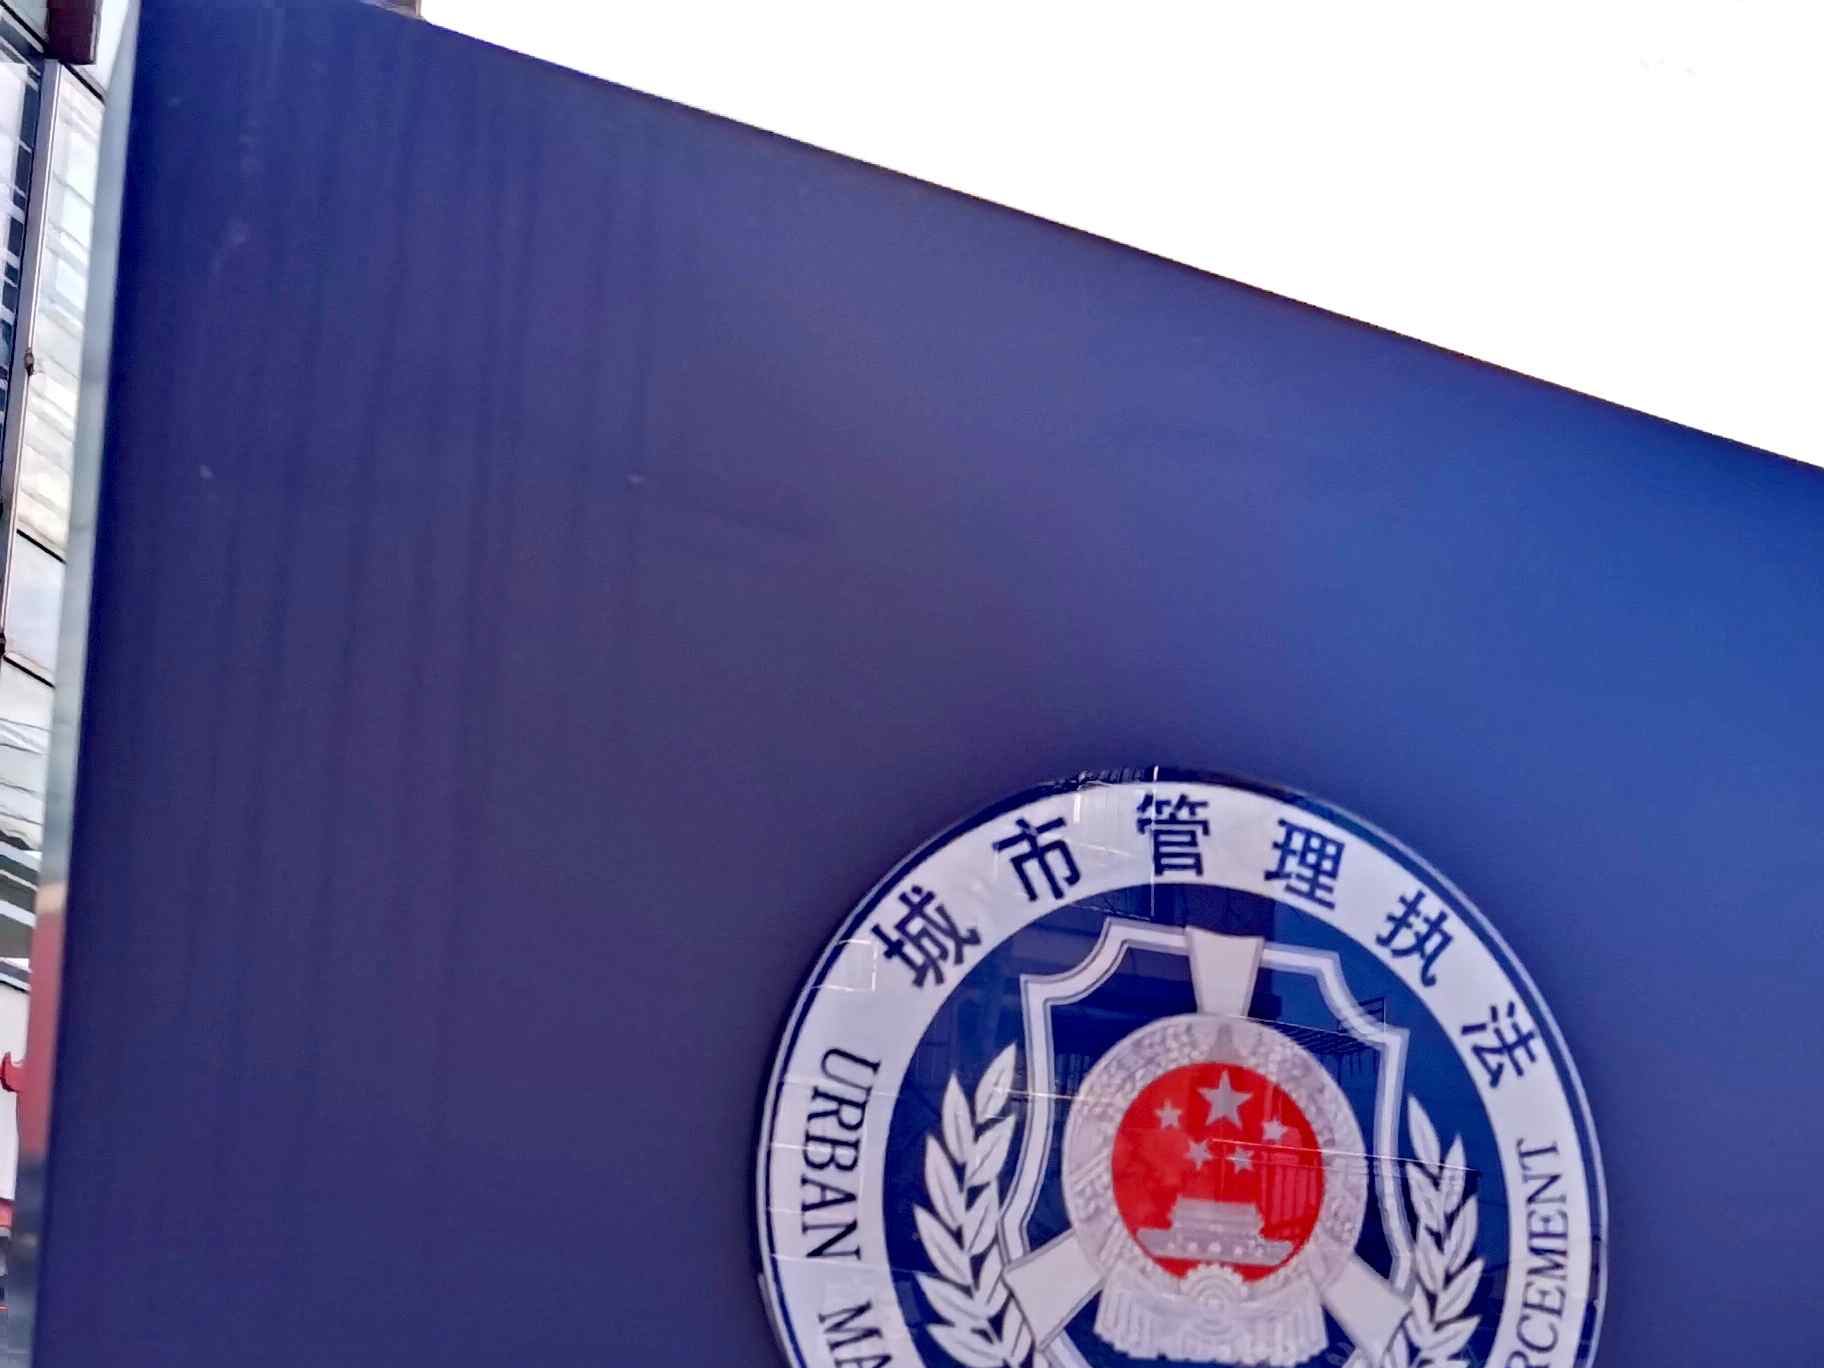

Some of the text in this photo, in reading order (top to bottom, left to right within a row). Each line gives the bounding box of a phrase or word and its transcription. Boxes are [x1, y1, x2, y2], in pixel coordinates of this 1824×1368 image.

[871, 793, 1541, 1090] 城市管理执法
[801, 1047, 881, 1262] URBAN
